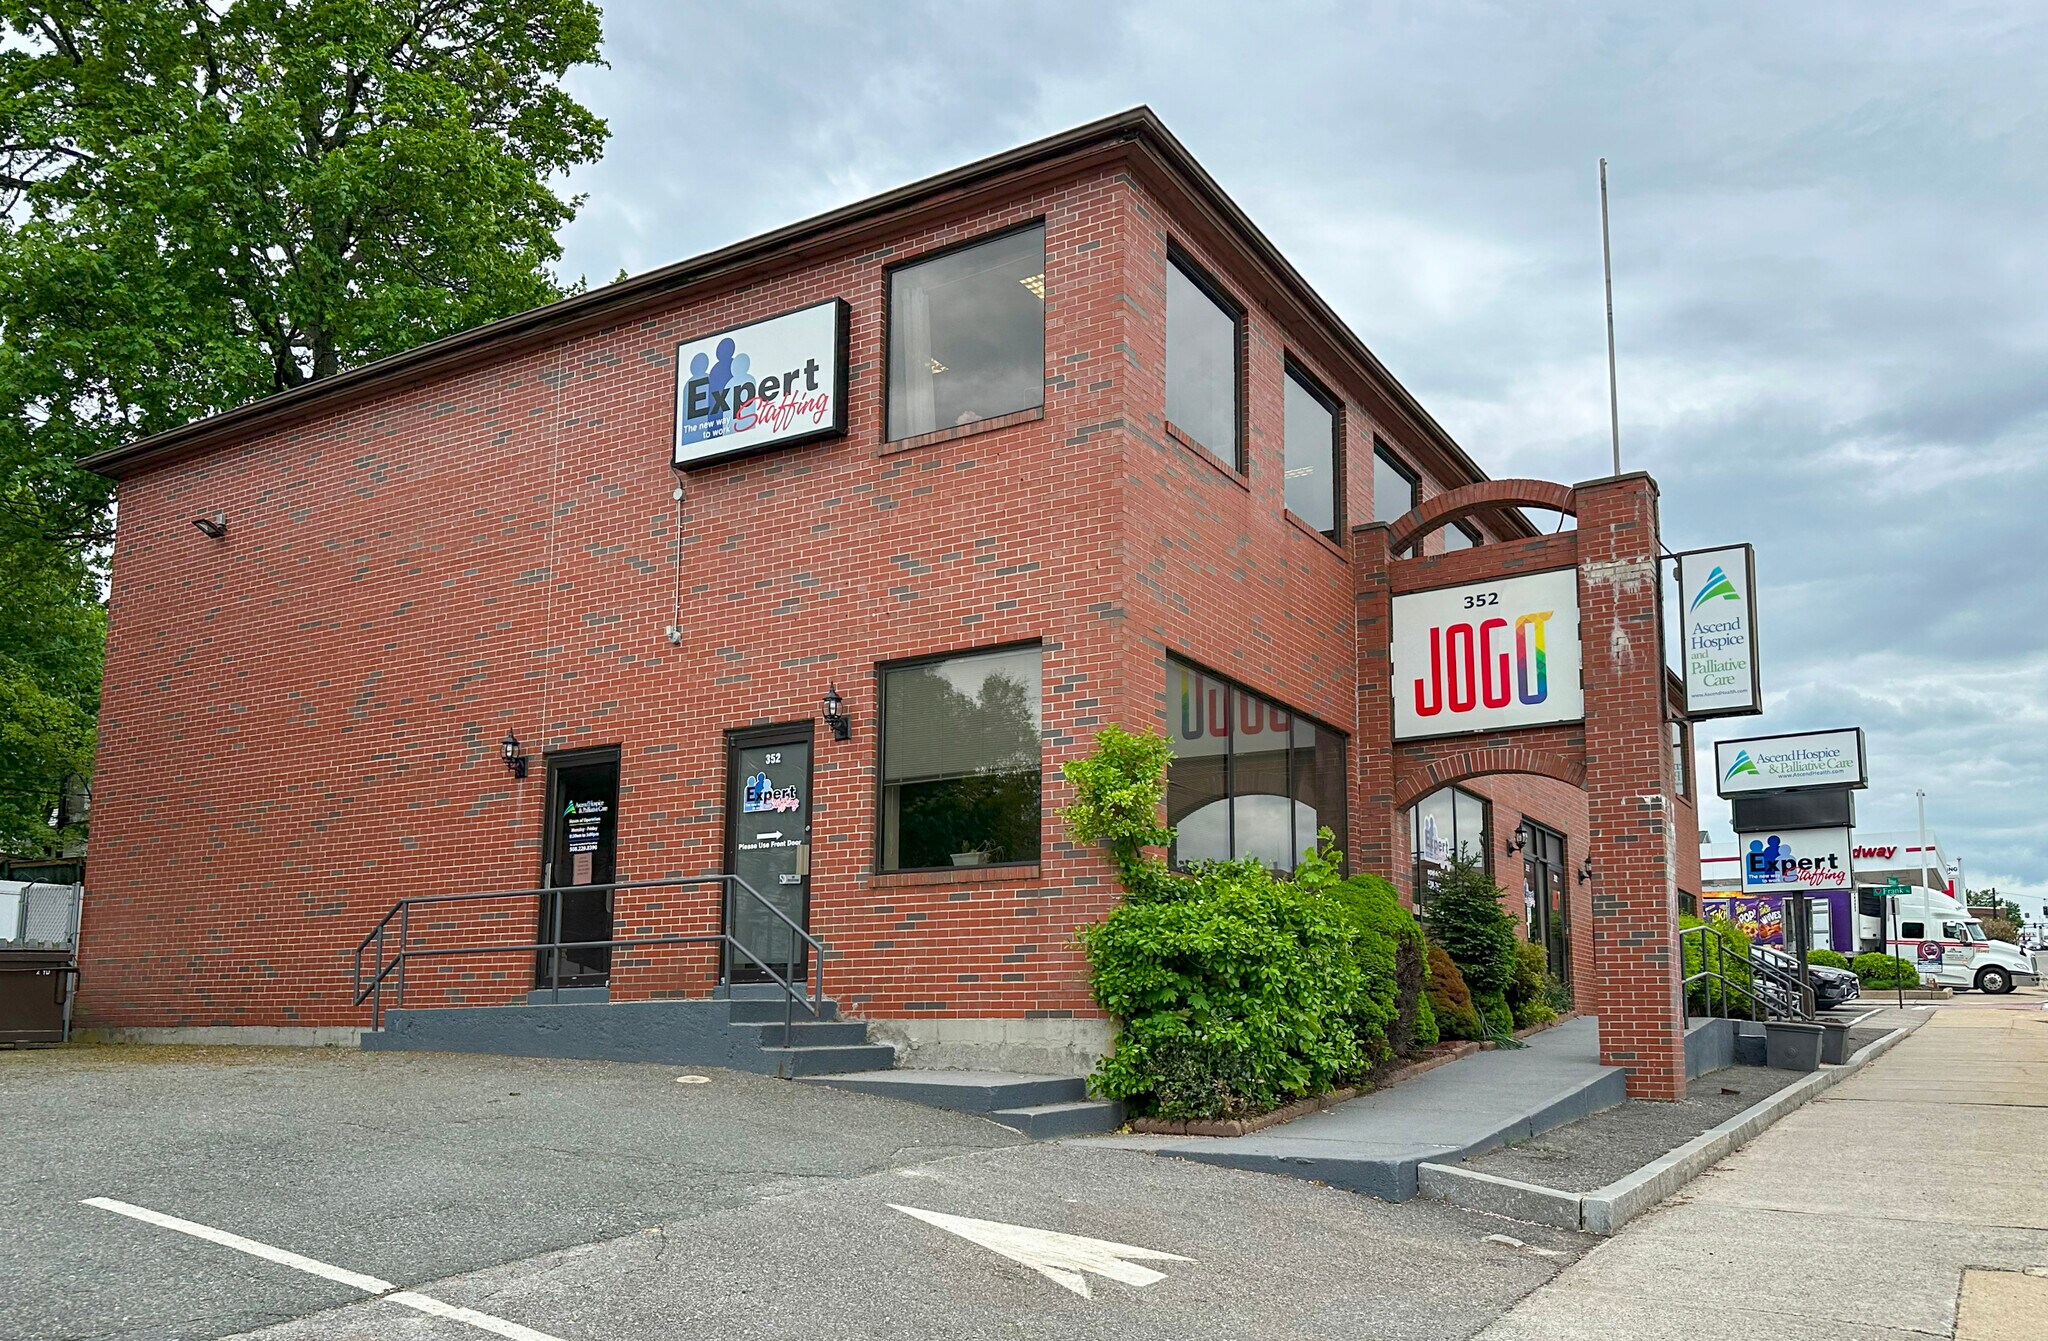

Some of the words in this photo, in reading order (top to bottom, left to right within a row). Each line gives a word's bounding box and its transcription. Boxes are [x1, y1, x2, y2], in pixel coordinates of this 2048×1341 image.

[687, 358, 819, 420] Expert
[733, 390, 829, 433] Staffing
[684, 424, 698, 433] The
[699, 420, 714, 430] new
[716, 417, 731, 426] way
[1464, 592, 1499, 609] 352
[1692, 616, 1741, 635] Ascend
[1691, 633, 1744, 651] Hospice
[1691, 649, 1709, 660] and
[1692, 658, 1746, 675] Palliative
[1703, 673, 1735, 687] Care
[765, 753, 781, 765] 352
[1768, 763, 1779, 774] &
[1780, 760, 1826, 773] Palliative
[1826, 758, 1854, 769] Care
[1778, 769, 1844, 779] www.AscendHealth.com
[746, 786, 797, 804] Expert
[770, 840, 786, 848] Front
[1750, 853, 1838, 876] Expert
[1783, 867, 1846, 886] Staffing
